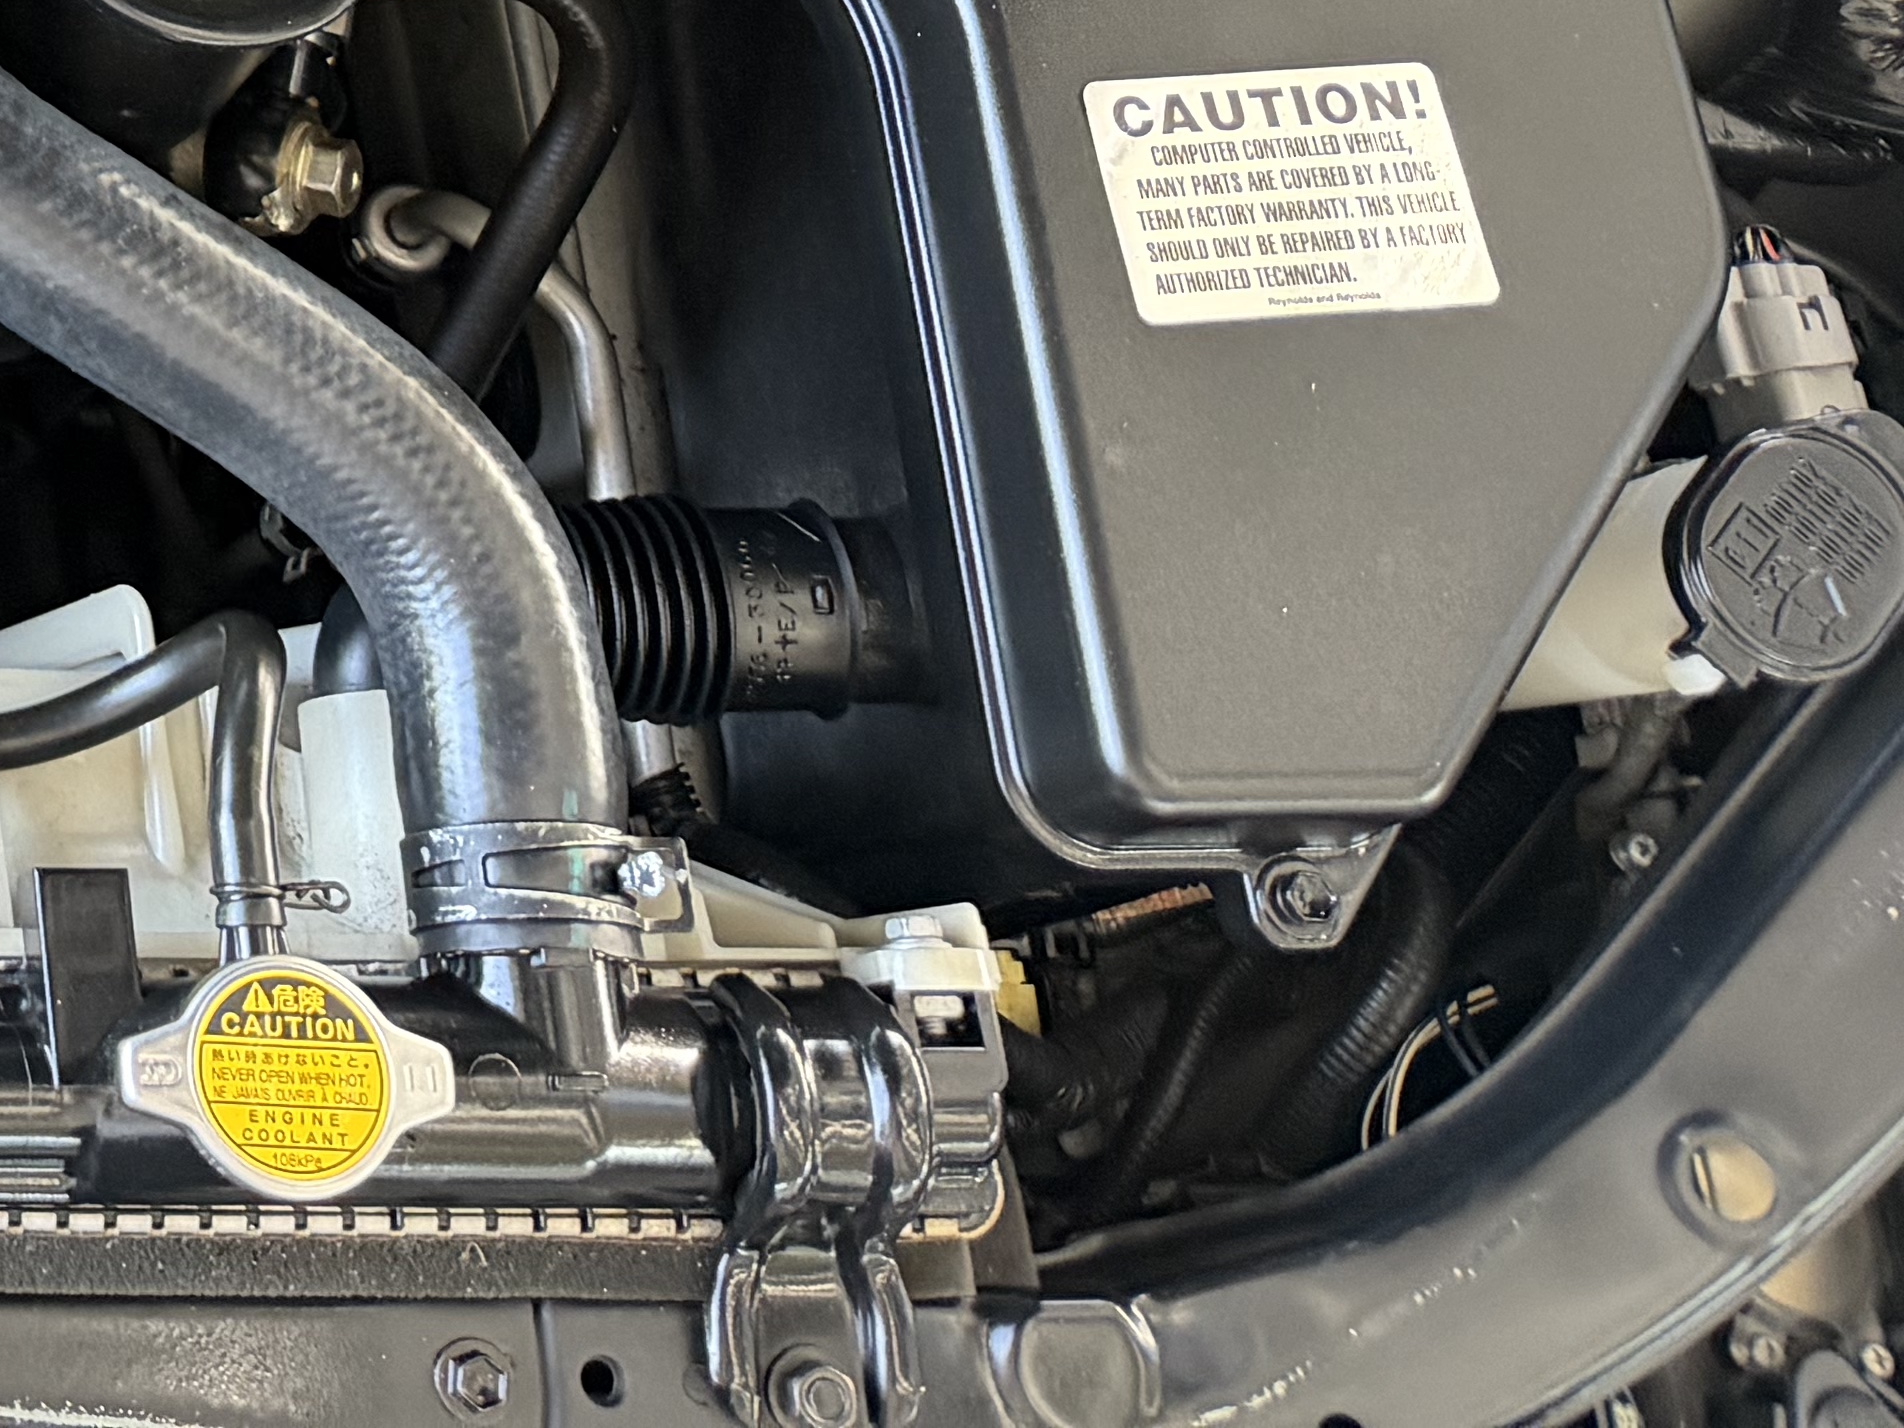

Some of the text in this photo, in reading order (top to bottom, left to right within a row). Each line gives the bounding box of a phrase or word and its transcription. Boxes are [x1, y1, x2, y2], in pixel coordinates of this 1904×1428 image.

[1112, 79, 1428, 138] CAUTION!
[1150, 130, 1414, 168] COMPUTER CONTROLLED VEHICLE,
[1136, 177, 1188, 200] MANY
[1191, 173, 1244, 197] PARTS
[1246, 171, 1278, 193] ARE
[1279, 166, 1350, 191] COVERED
[1351, 164, 1377, 186] BY
[1379, 163, 1392, 185] A
[1137, 190, 1463, 232] TERM FACTORY WARRANTY. THIS VEHICLE
[1146, 222, 1468, 264] SHOULD ONLY BE REPAIRED BY A FACTORY
[1154, 262, 1358, 296] AUTHORIZED TECHNICIAN.
[1268, 291, 1382, 307] Reynolds and Reynolds
[272, 984, 327, 1015] 危険
[221, 1012, 355, 1040] CAUTION
[212, 1067, 371, 1089] NEVER OPEN WHEN HOT.
[213, 1085, 227, 1098] NE
[232, 1087, 271, 1101] JAMAIS
[275, 1089, 316, 1103] OUVRIR
[249, 1110, 340, 1127] ENGINE
[242, 1128, 349, 1146] COOLANT
